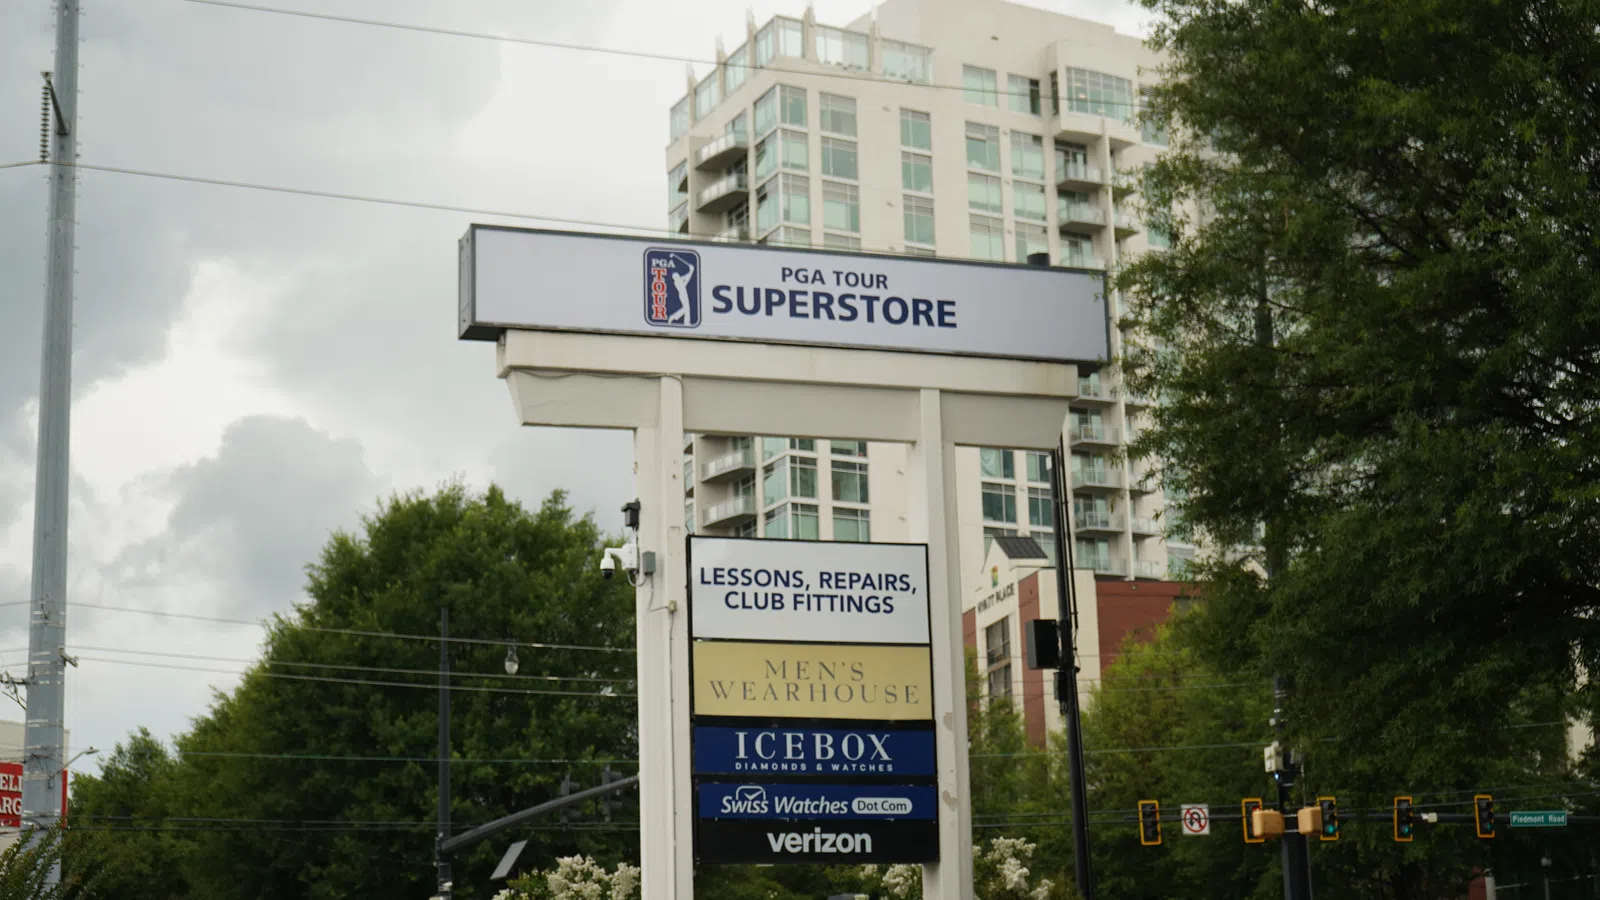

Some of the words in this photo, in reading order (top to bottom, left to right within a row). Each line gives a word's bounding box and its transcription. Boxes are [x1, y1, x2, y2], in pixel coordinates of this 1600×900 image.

[651, 259, 676, 268] PGA
[781, 267, 825, 285] PGA
[833, 270, 888, 290] TOUR
[651, 267, 668, 320] TOUR
[712, 284, 957, 328] SUPERSTORE
[700, 567, 811, 591] LESSONS,
[819, 571, 917, 595] REPAIRS,
[724, 591, 785, 611] CLUB
[793, 593, 894, 614] FITTINGS
[764, 660, 864, 682] MEN'S
[709, 680, 919, 704] WEARHOUSE
[735, 731, 892, 761] ICEBOX
[735, 762, 807, 771] DIAMONDS
[816, 763, 823, 771] &
[832, 763, 893, 772] WATCHES
[721, 795, 769, 814] Swiss
[774, 795, 848, 815] Watches
[857, 801, 878, 811] Dot
[881, 801, 907, 811] Com
[1512, 815, 1544, 823] Piedmont
[1548, 814, 1565, 823] Road
[767, 826, 872, 853] verizon
